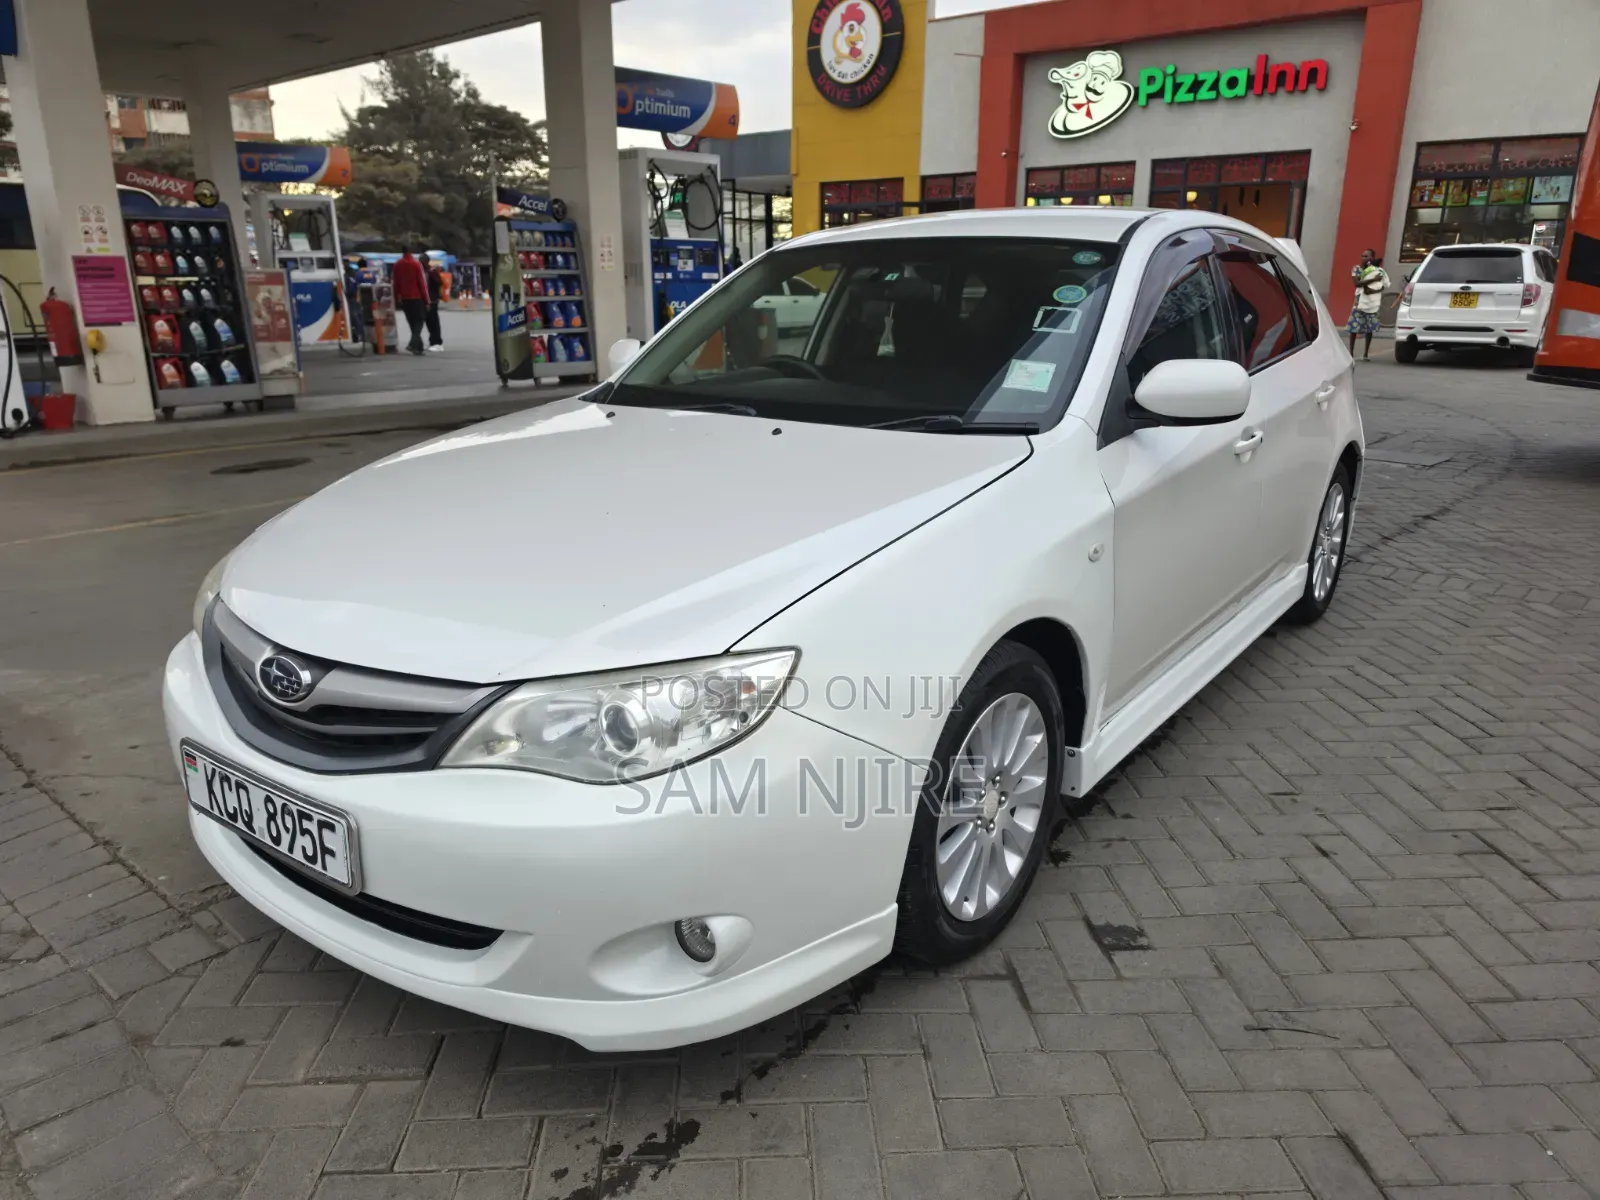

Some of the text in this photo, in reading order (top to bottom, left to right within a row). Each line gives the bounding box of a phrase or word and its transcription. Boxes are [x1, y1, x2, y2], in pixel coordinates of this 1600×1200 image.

[817, 64, 887, 103] DRIVE THRU
[728, 115, 736, 126] 4
[126, 172, 187, 194] DeoMAX
[518, 195, 549, 211] Accel
[204, 763, 336, 872] KCQ 895F
